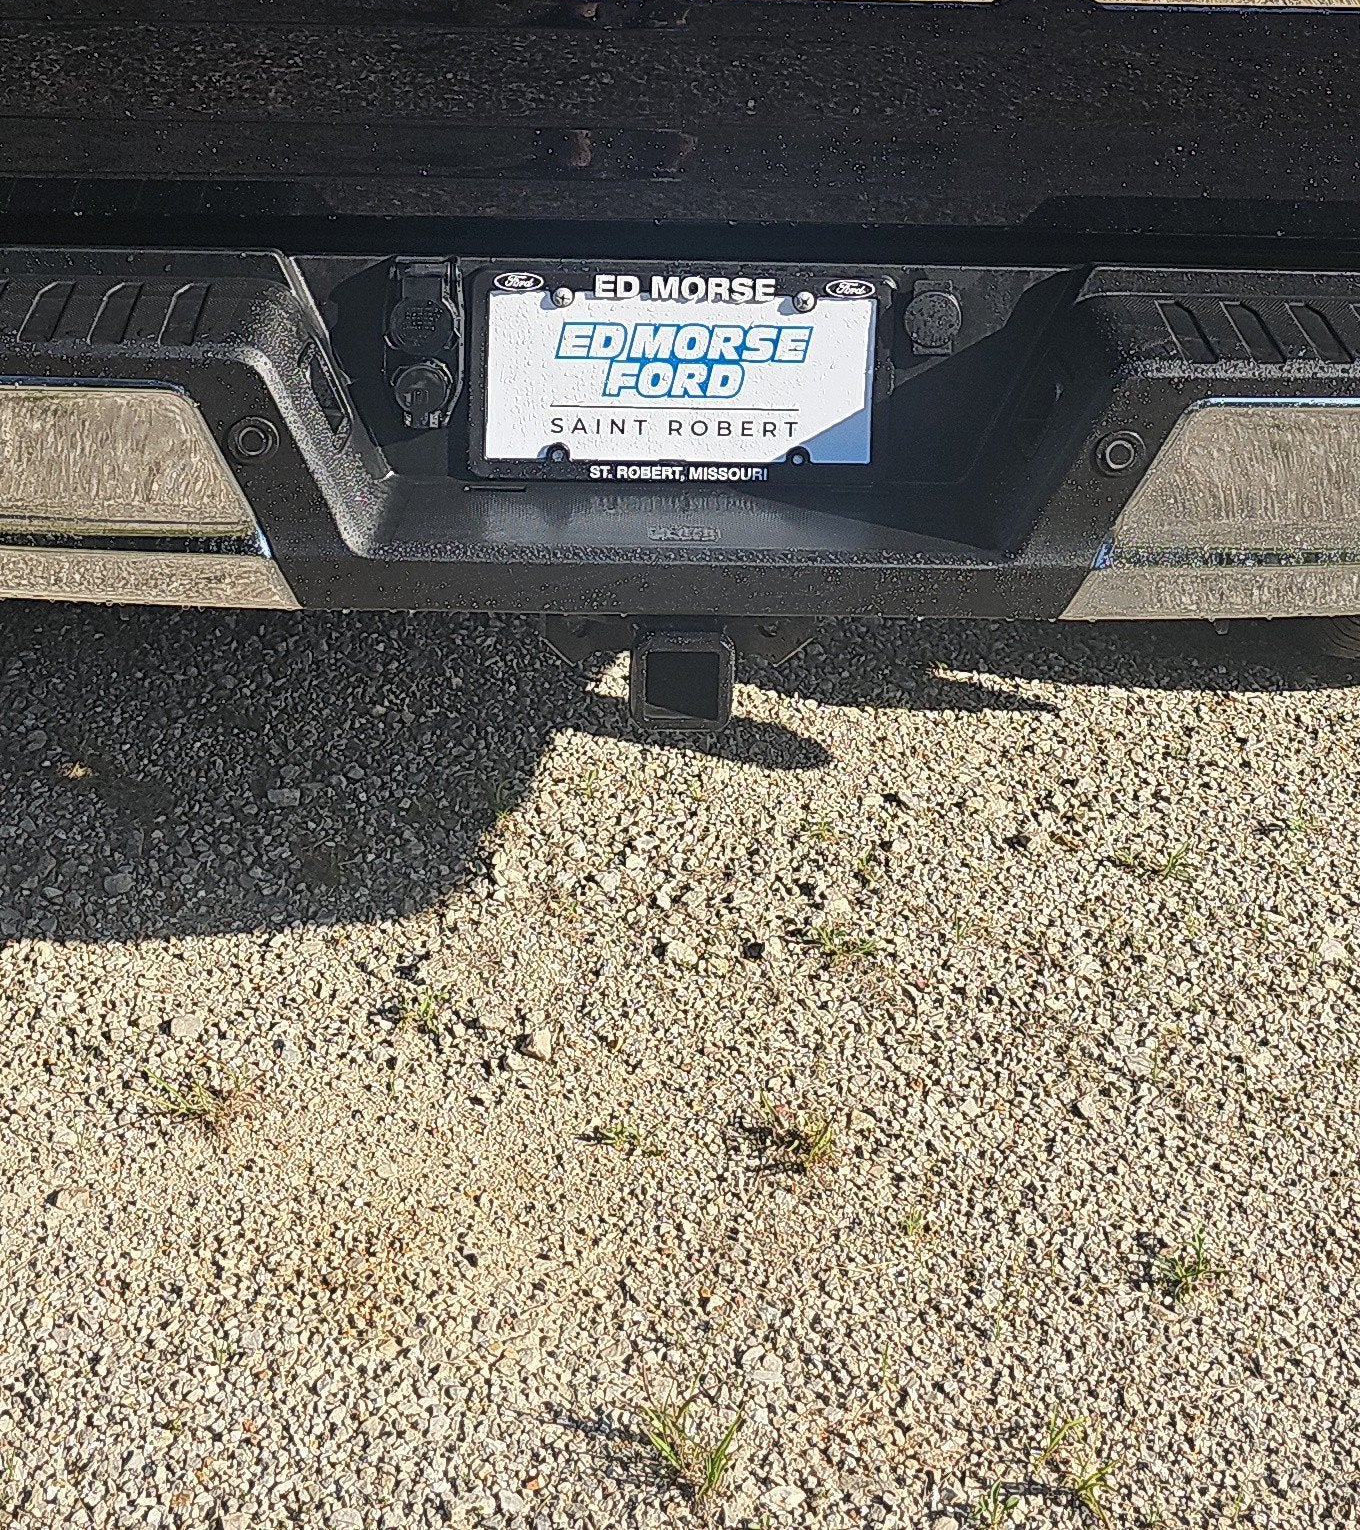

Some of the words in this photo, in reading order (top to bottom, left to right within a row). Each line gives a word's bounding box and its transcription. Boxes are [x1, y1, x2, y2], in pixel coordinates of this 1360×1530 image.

[504, 274, 535, 288] Ford
[594, 274, 640, 299] ED
[651, 276, 776, 302] MORSE
[836, 281, 866, 295] Ford
[554, 322, 627, 359] ED
[627, 323, 814, 363] MORSE
[602, 361, 745, 398] FORD
[550, 417, 648, 435] SAINT
[668, 419, 799, 437] ROBERT
[589, 466, 613, 479] ST.
[616, 466, 685, 481] ROBERT,
[689, 467, 768, 481] MISSOURI
